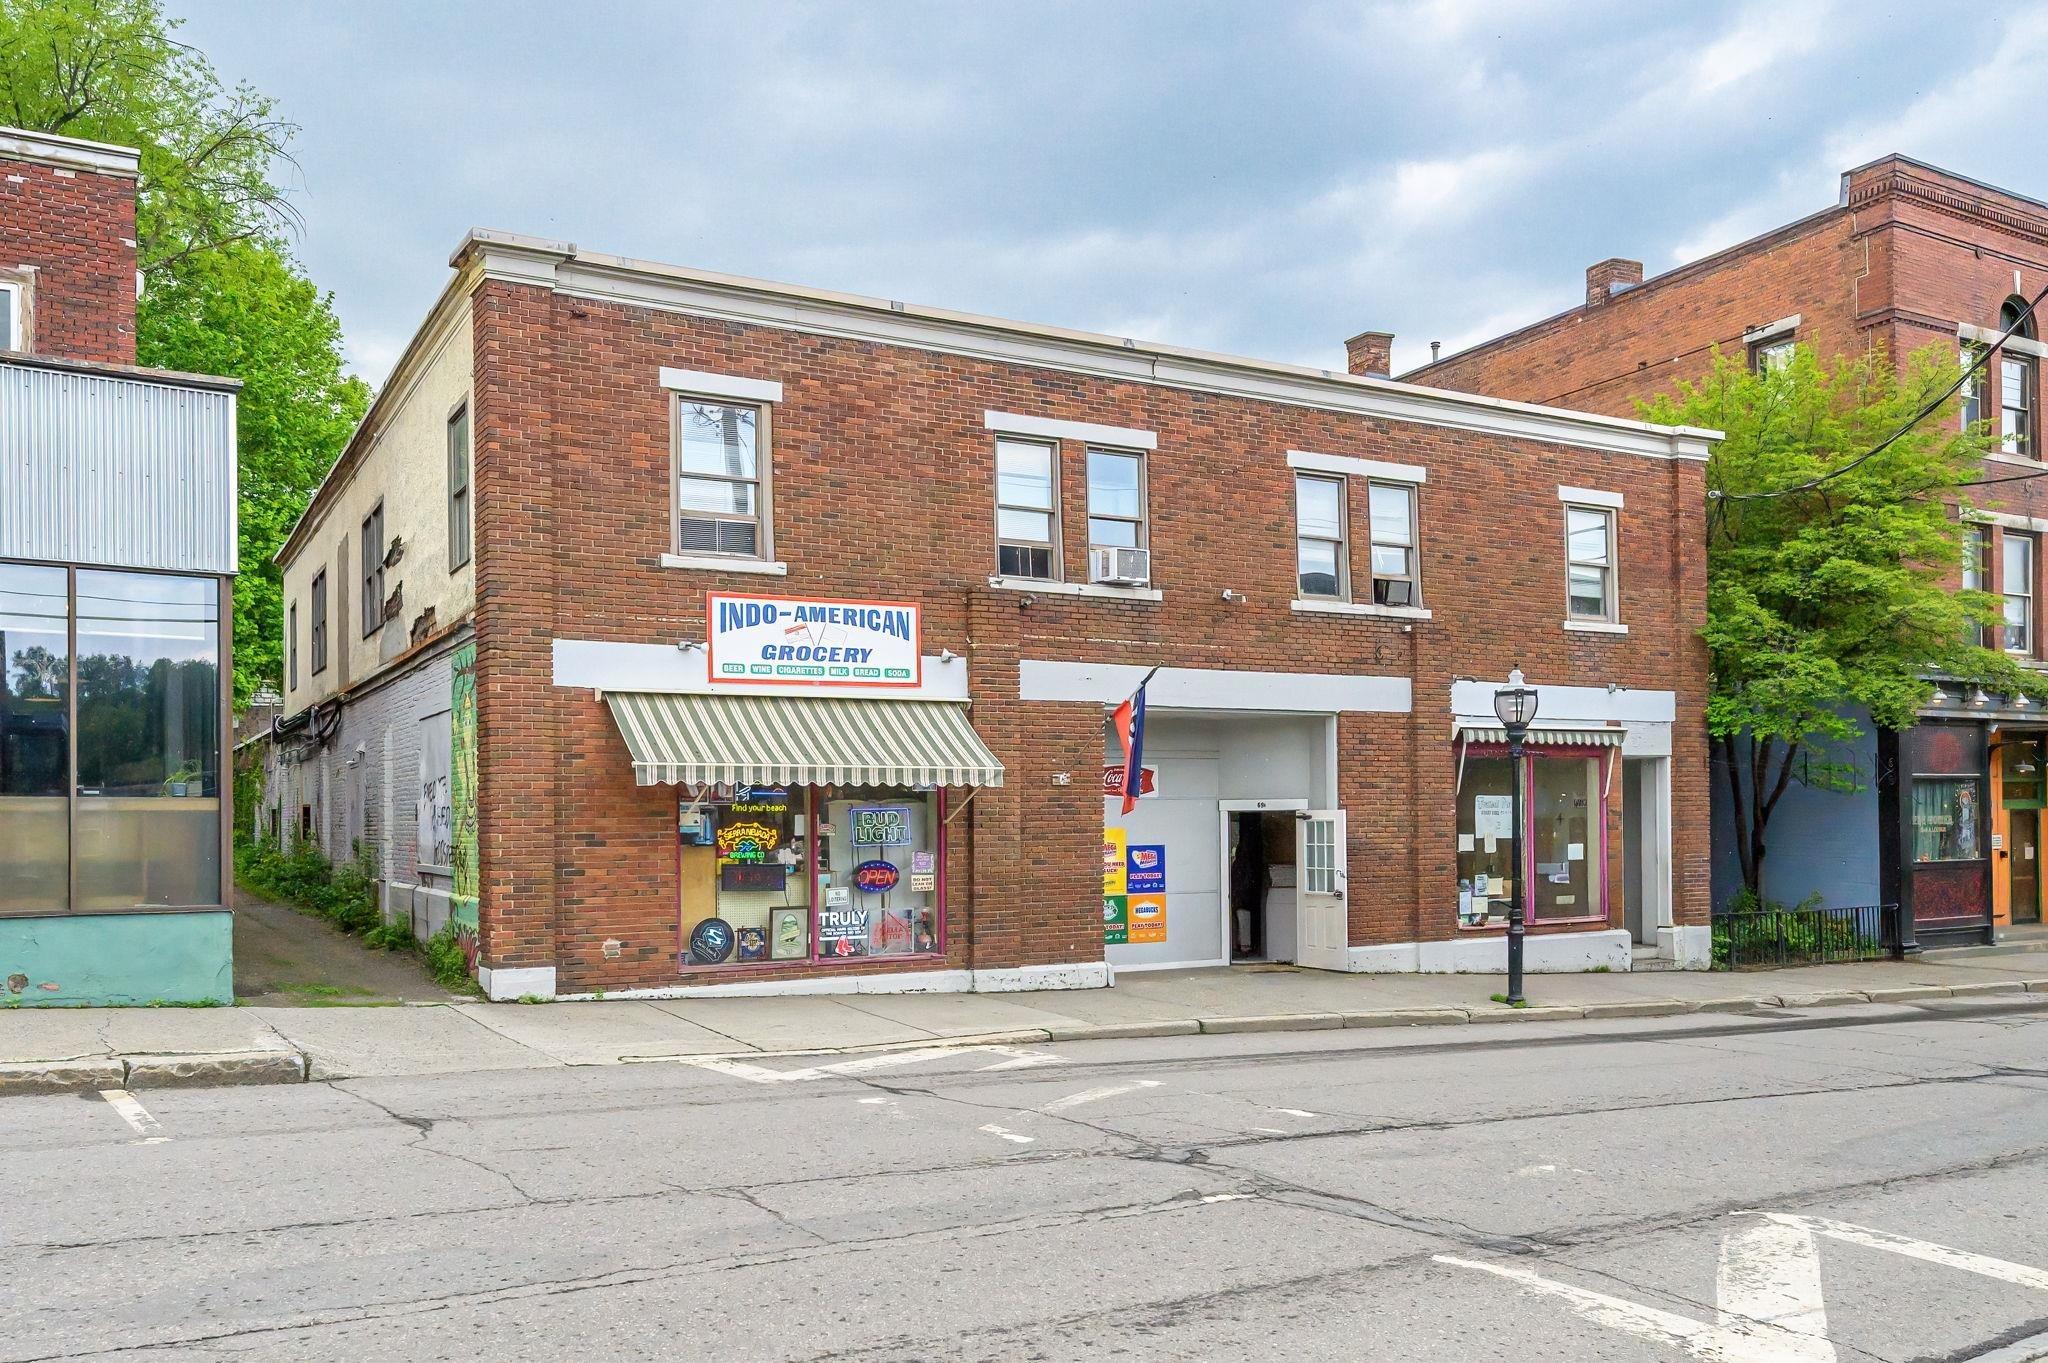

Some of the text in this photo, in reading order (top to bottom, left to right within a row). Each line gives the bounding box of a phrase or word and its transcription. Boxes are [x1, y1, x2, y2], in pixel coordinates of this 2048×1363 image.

[720, 602, 910, 641] INDO-AMERICAN
[761, 644, 873, 663] GROCERY
[723, 664, 744, 672] BEER
[752, 665, 771, 673] WINE
[778, 666, 822, 675] CIGARETTES
[854, 668, 879, 676] BREAD
[731, 804, 787, 813] Find your beach
[862, 811, 900, 826] BUD
[855, 826, 907, 842] LIGHT
[730, 851, 756, 859] BREWING
[858, 870, 896, 885] OPEN
[819, 910, 868, 926] TRULY
